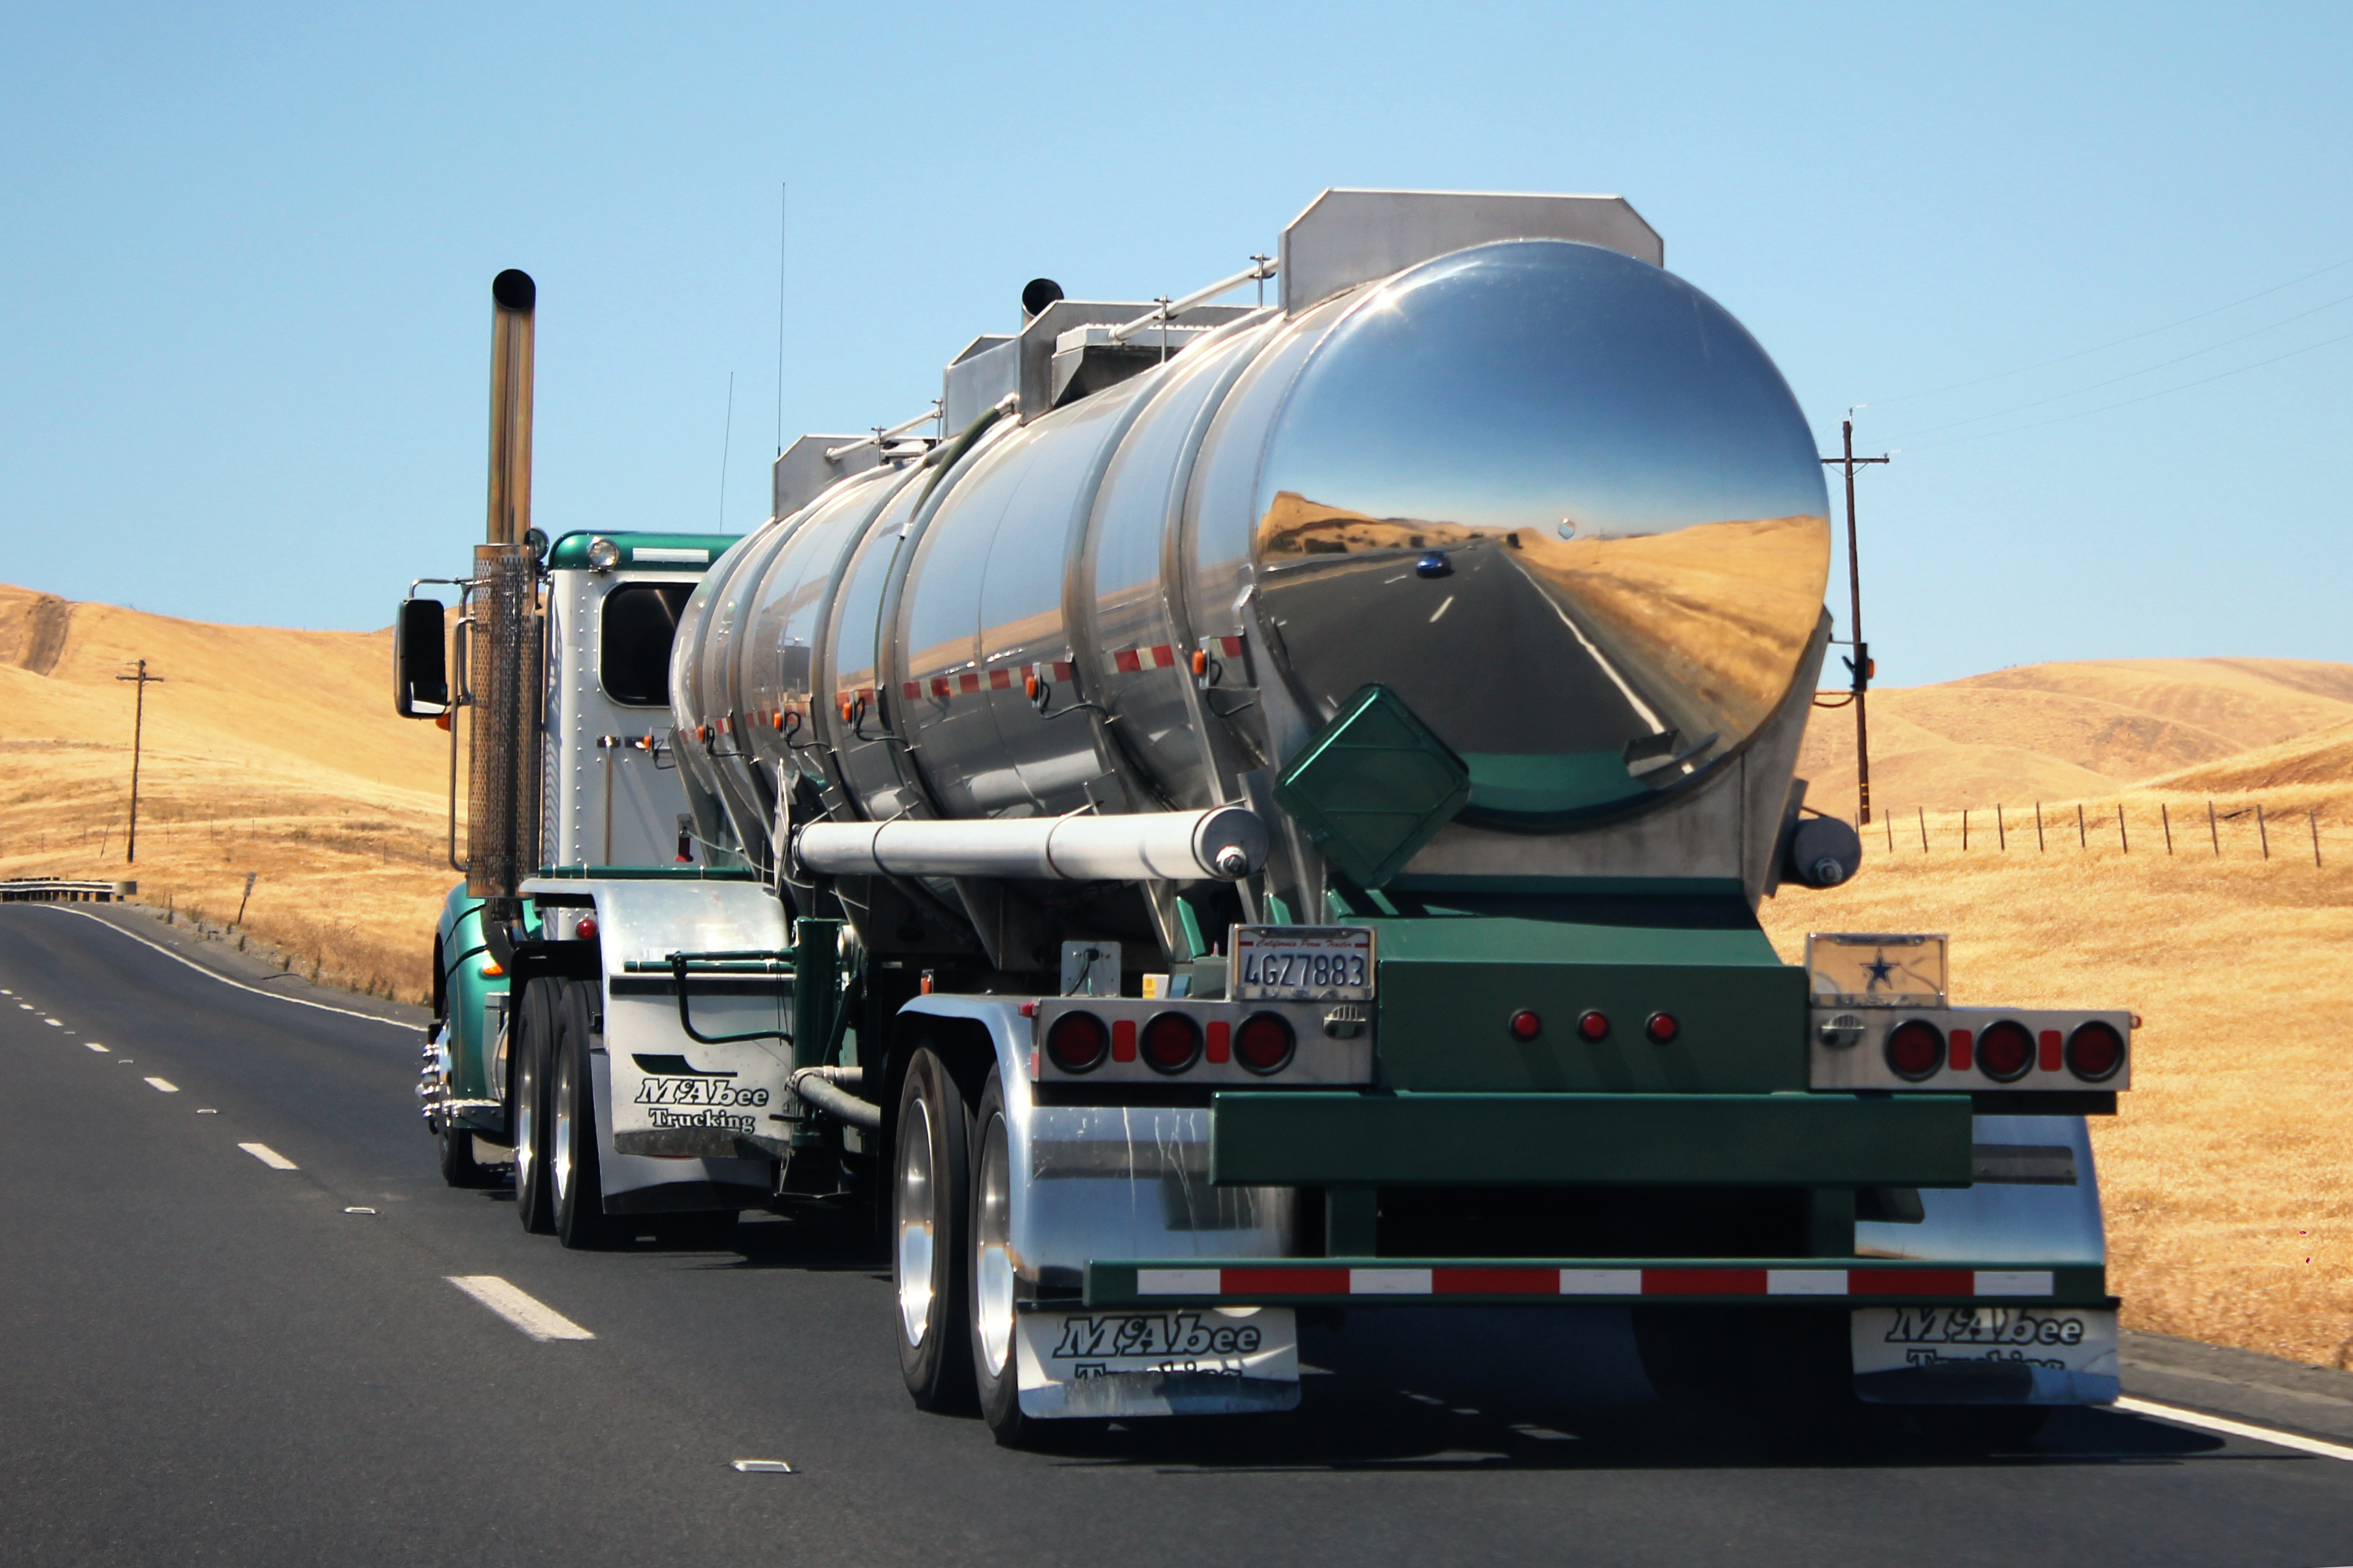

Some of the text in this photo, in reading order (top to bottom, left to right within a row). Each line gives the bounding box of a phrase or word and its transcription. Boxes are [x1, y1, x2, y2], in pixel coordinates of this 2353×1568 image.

[1256, 938, 1353, 949] California Perm Trailer
[1244, 953, 1365, 986] 4GZ7883
[634, 1077, 770, 1107] McAbee
[649, 1107, 756, 1134] Trucking
[1051, 1314, 1262, 1358] McAbee
[1884, 1307, 2084, 1345] McAbee
